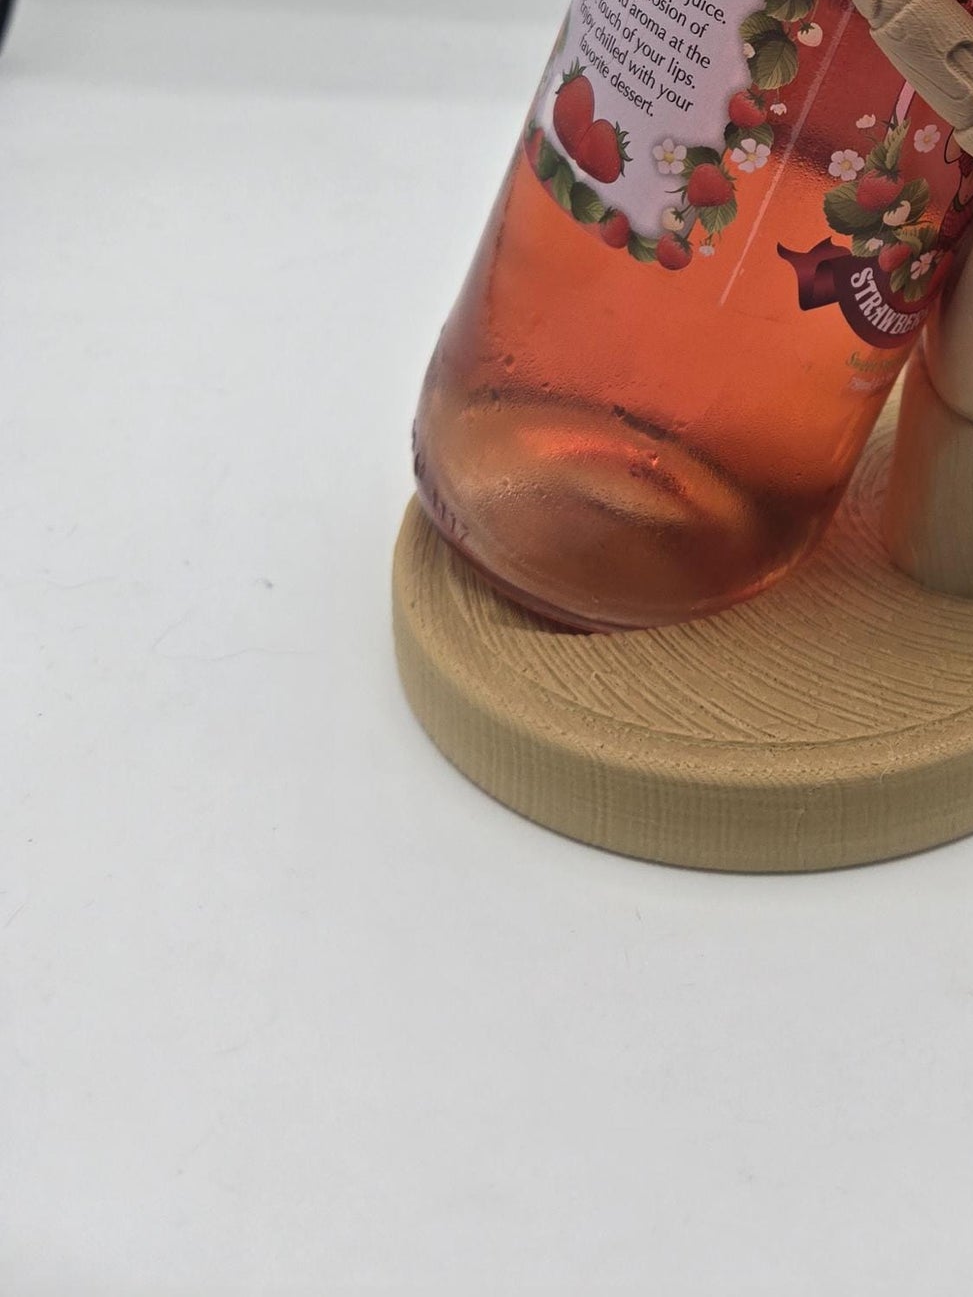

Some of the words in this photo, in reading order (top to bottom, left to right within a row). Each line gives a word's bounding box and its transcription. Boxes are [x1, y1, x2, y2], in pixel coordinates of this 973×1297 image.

[622, 26, 637, 43] of
[634, 37, 666, 67] your
[667, 57, 696, 89] lips.
[629, 3, 667, 41] aroma
[669, 35, 683, 53] at
[686, 44, 711, 69] the
[689, 22, 709, 38] of
[579, 33, 609, 78] favorite
[610, 72, 654, 117] dessert.
[595, 25, 629, 65] chilled
[628, 60, 656, 89] with
[656, 83, 694, 113] your
